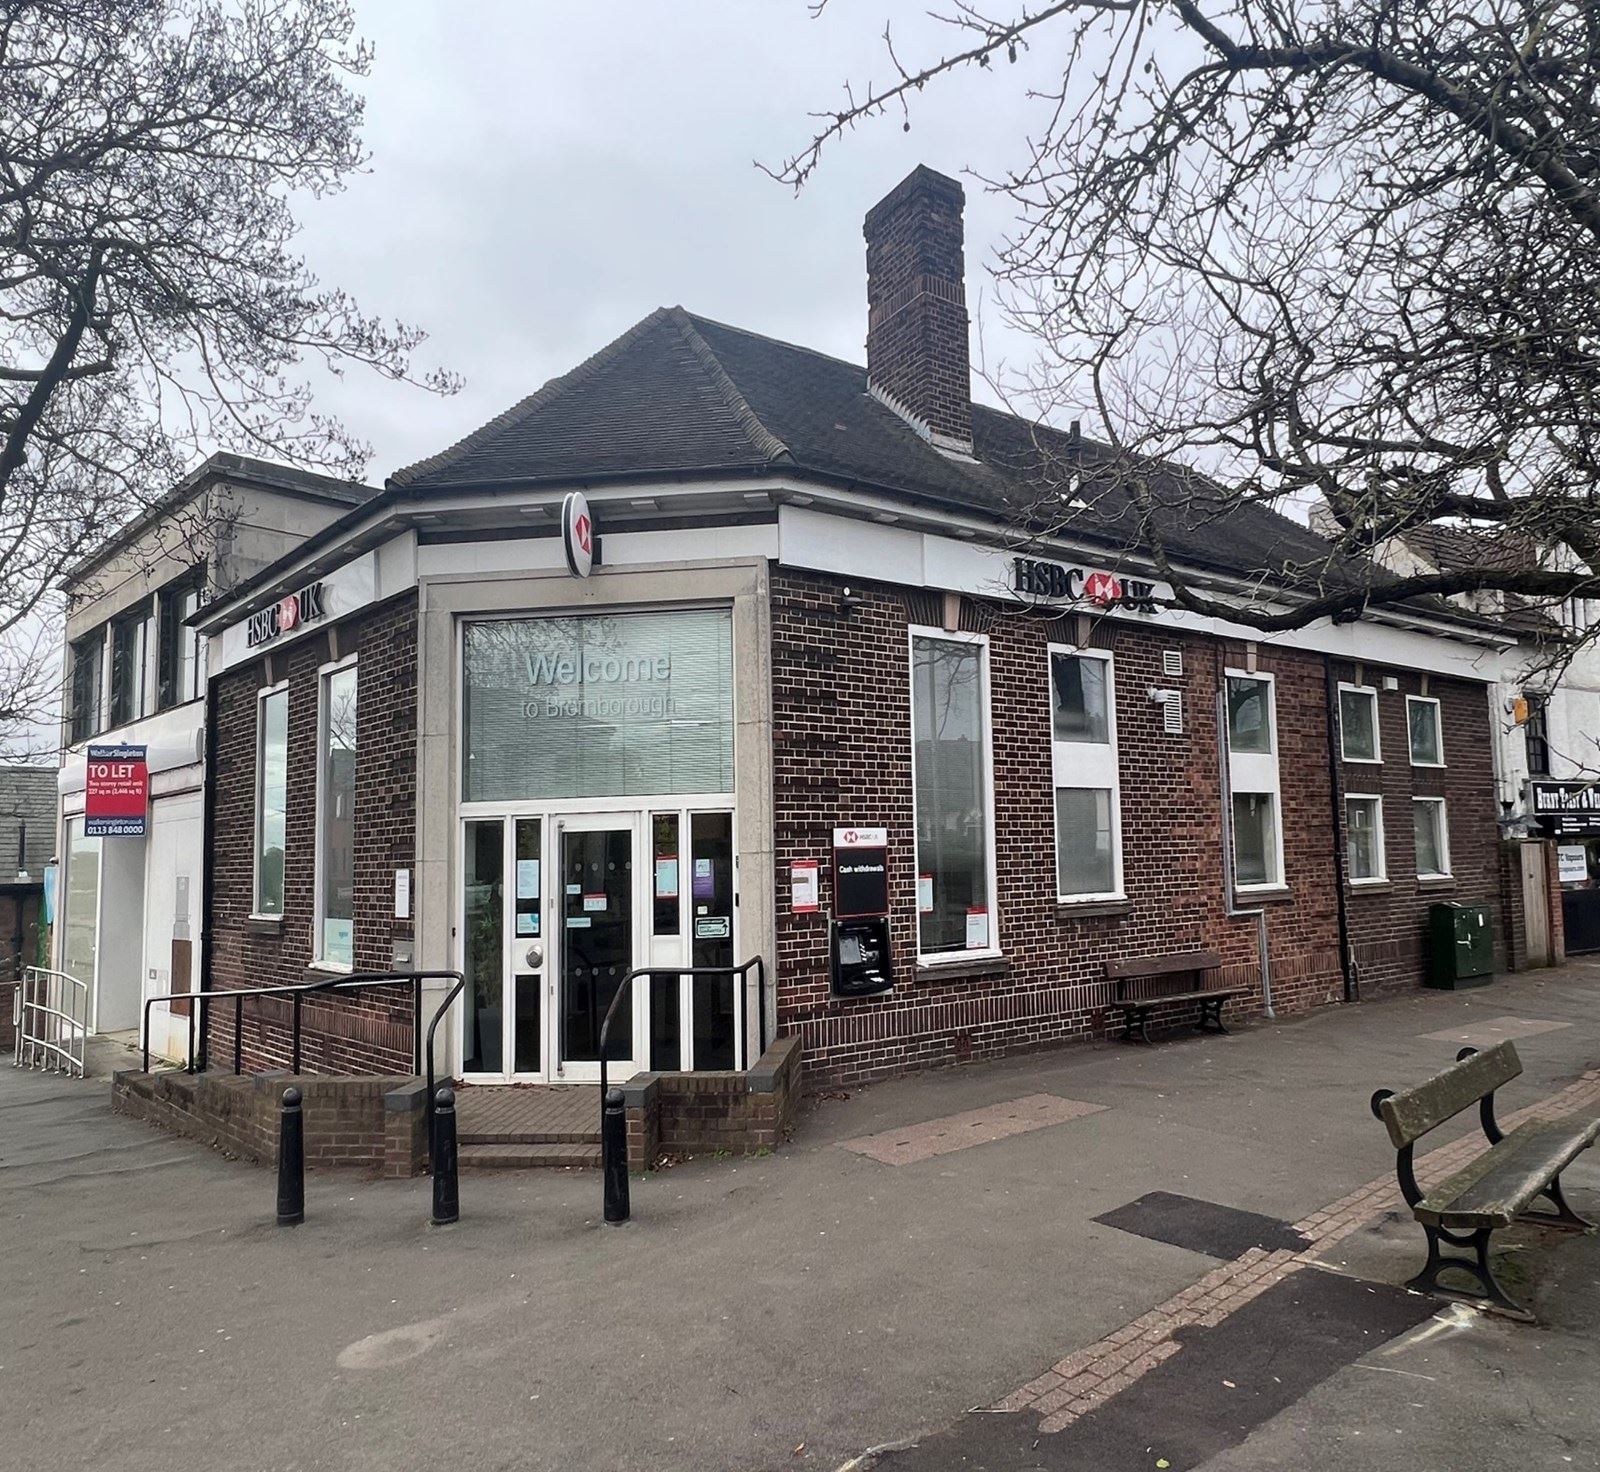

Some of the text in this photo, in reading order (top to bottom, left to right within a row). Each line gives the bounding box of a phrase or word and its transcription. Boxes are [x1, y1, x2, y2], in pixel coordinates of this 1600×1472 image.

[1013, 557, 1159, 614] HSBC UK
[246, 582, 326, 648] HSBC UK
[526, 650, 672, 687] Welcome
[521, 695, 679, 718] to Bromborough
[89, 765, 135, 778] TO LET
[88, 826, 107, 835] 0113
[123, 825, 144, 834] 0000
[839, 865, 853, 873] Cash
